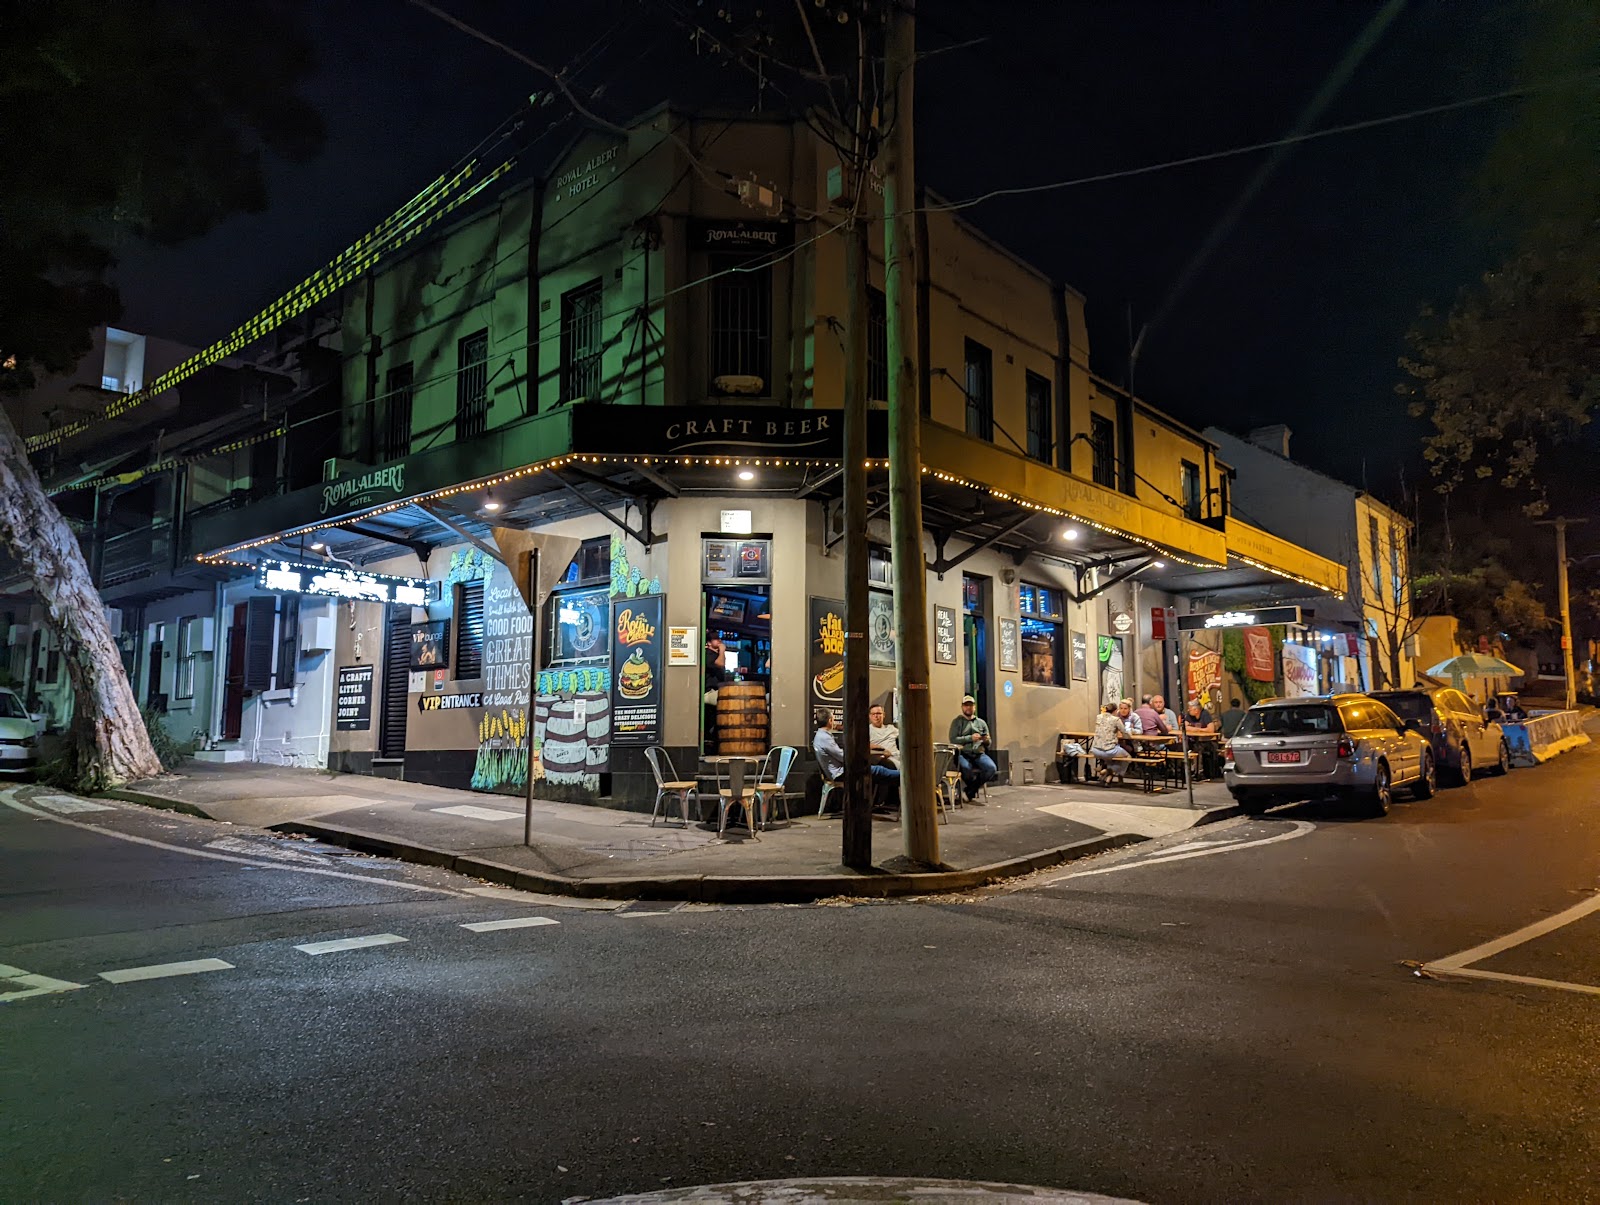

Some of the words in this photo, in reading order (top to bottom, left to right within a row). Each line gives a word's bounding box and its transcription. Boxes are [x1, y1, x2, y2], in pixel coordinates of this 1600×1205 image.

[557, 166, 583, 188] ROYAL
[585, 145, 618, 173] ALBERT
[569, 174, 599, 197] HOTEL
[704, 229, 738, 243] ROYAL
[740, 230, 777, 245] ALBERT
[666, 418, 752, 440] CRAFT
[765, 415, 830, 436] BEER
[319, 478, 359, 515] ROYAL
[358, 463, 405, 493] ALBERT
[349, 495, 373, 507] HOTEL
[937, 610, 949, 620] REAL
[487, 618, 510, 637] GOOD
[511, 616, 533, 635] FOOD
[937, 627, 949, 637] REAL
[424, 631, 443, 642] lounge
[819, 629, 844, 642] ALBER
[486, 636, 533, 664] GREAT
[823, 639, 843, 655] DOG
[937, 643, 949, 653] REAL
[339, 674, 345, 683] A
[346, 672, 372, 682] CRAFTY
[486, 662, 531, 691] TIMES
[339, 684, 363, 694] LITTLE
[338, 695, 366, 705] CORNER
[423, 695, 441, 710] VIP
[441, 693, 481, 709] ENTRANCE
[494, 692, 513, 706] Good
[513, 690, 530, 706] Pub
[338, 707, 359, 717] JOINT
